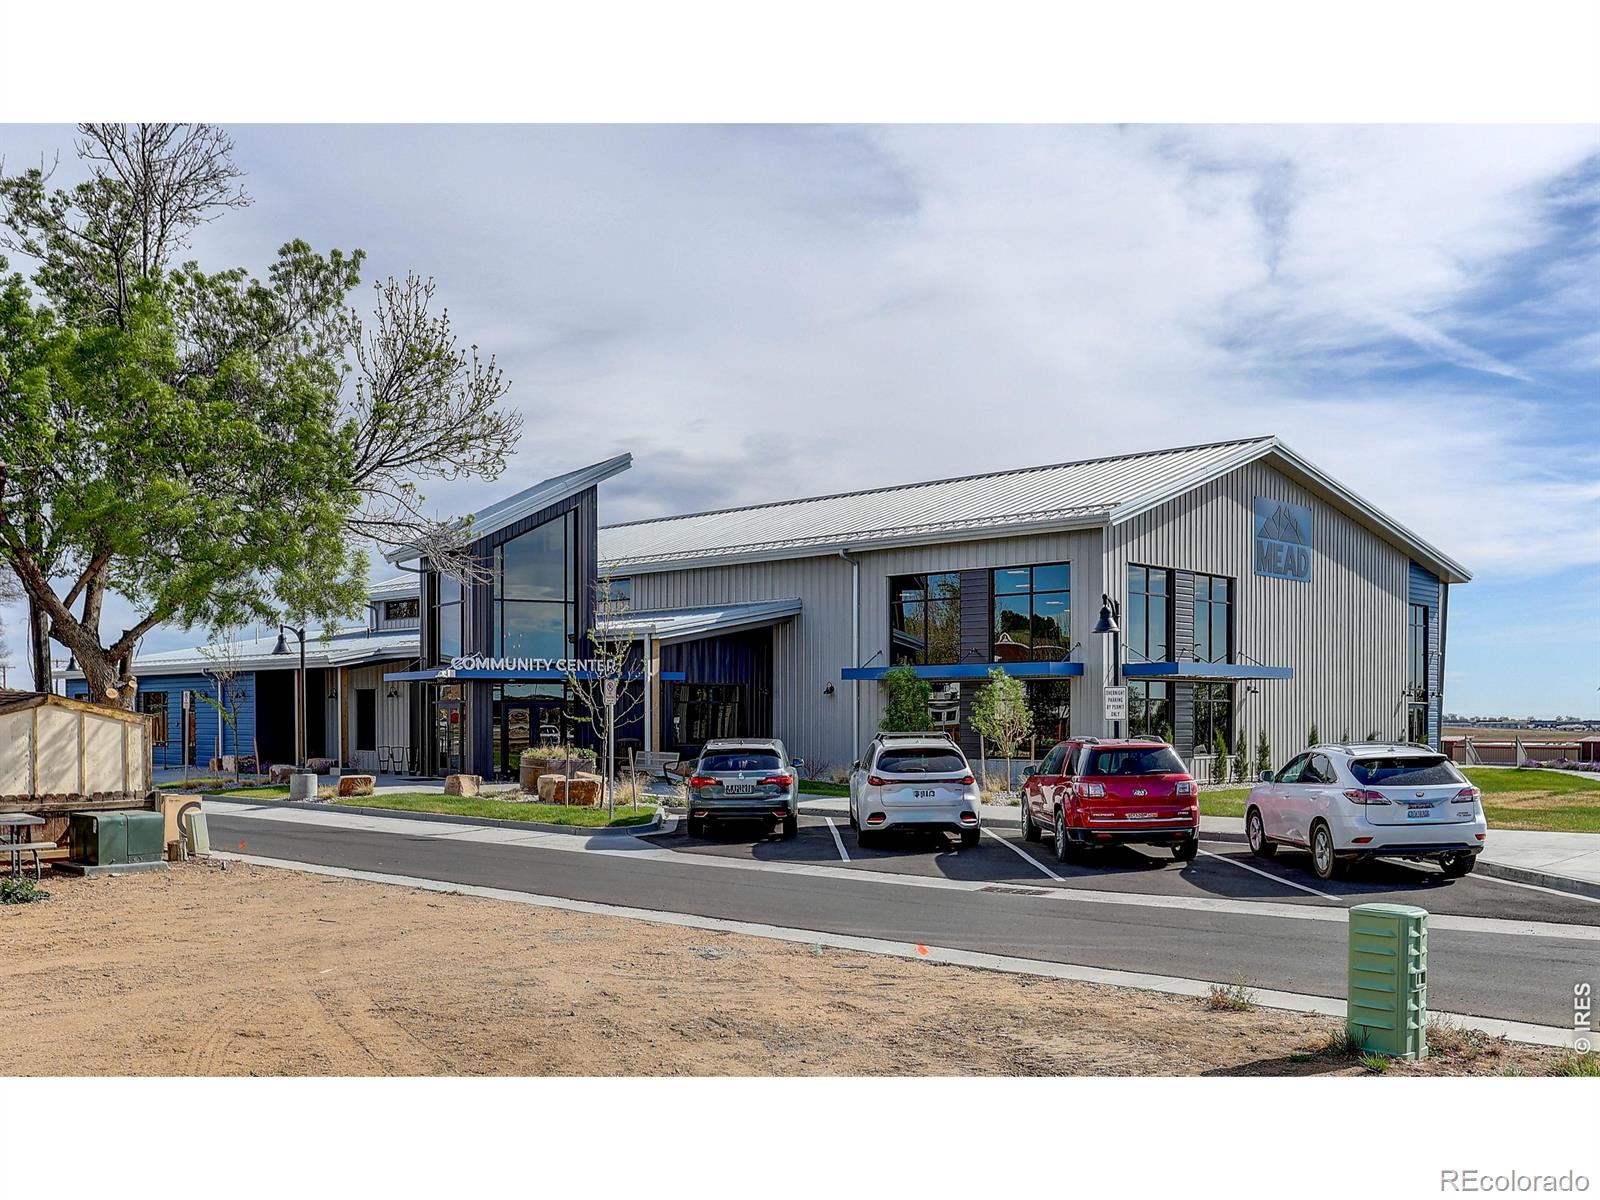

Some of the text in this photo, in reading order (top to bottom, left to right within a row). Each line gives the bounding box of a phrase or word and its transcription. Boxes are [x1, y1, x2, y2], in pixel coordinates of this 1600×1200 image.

[1256, 540, 1310, 578] MEAD
[450, 657, 617, 673] COMMUNITY CENTER
